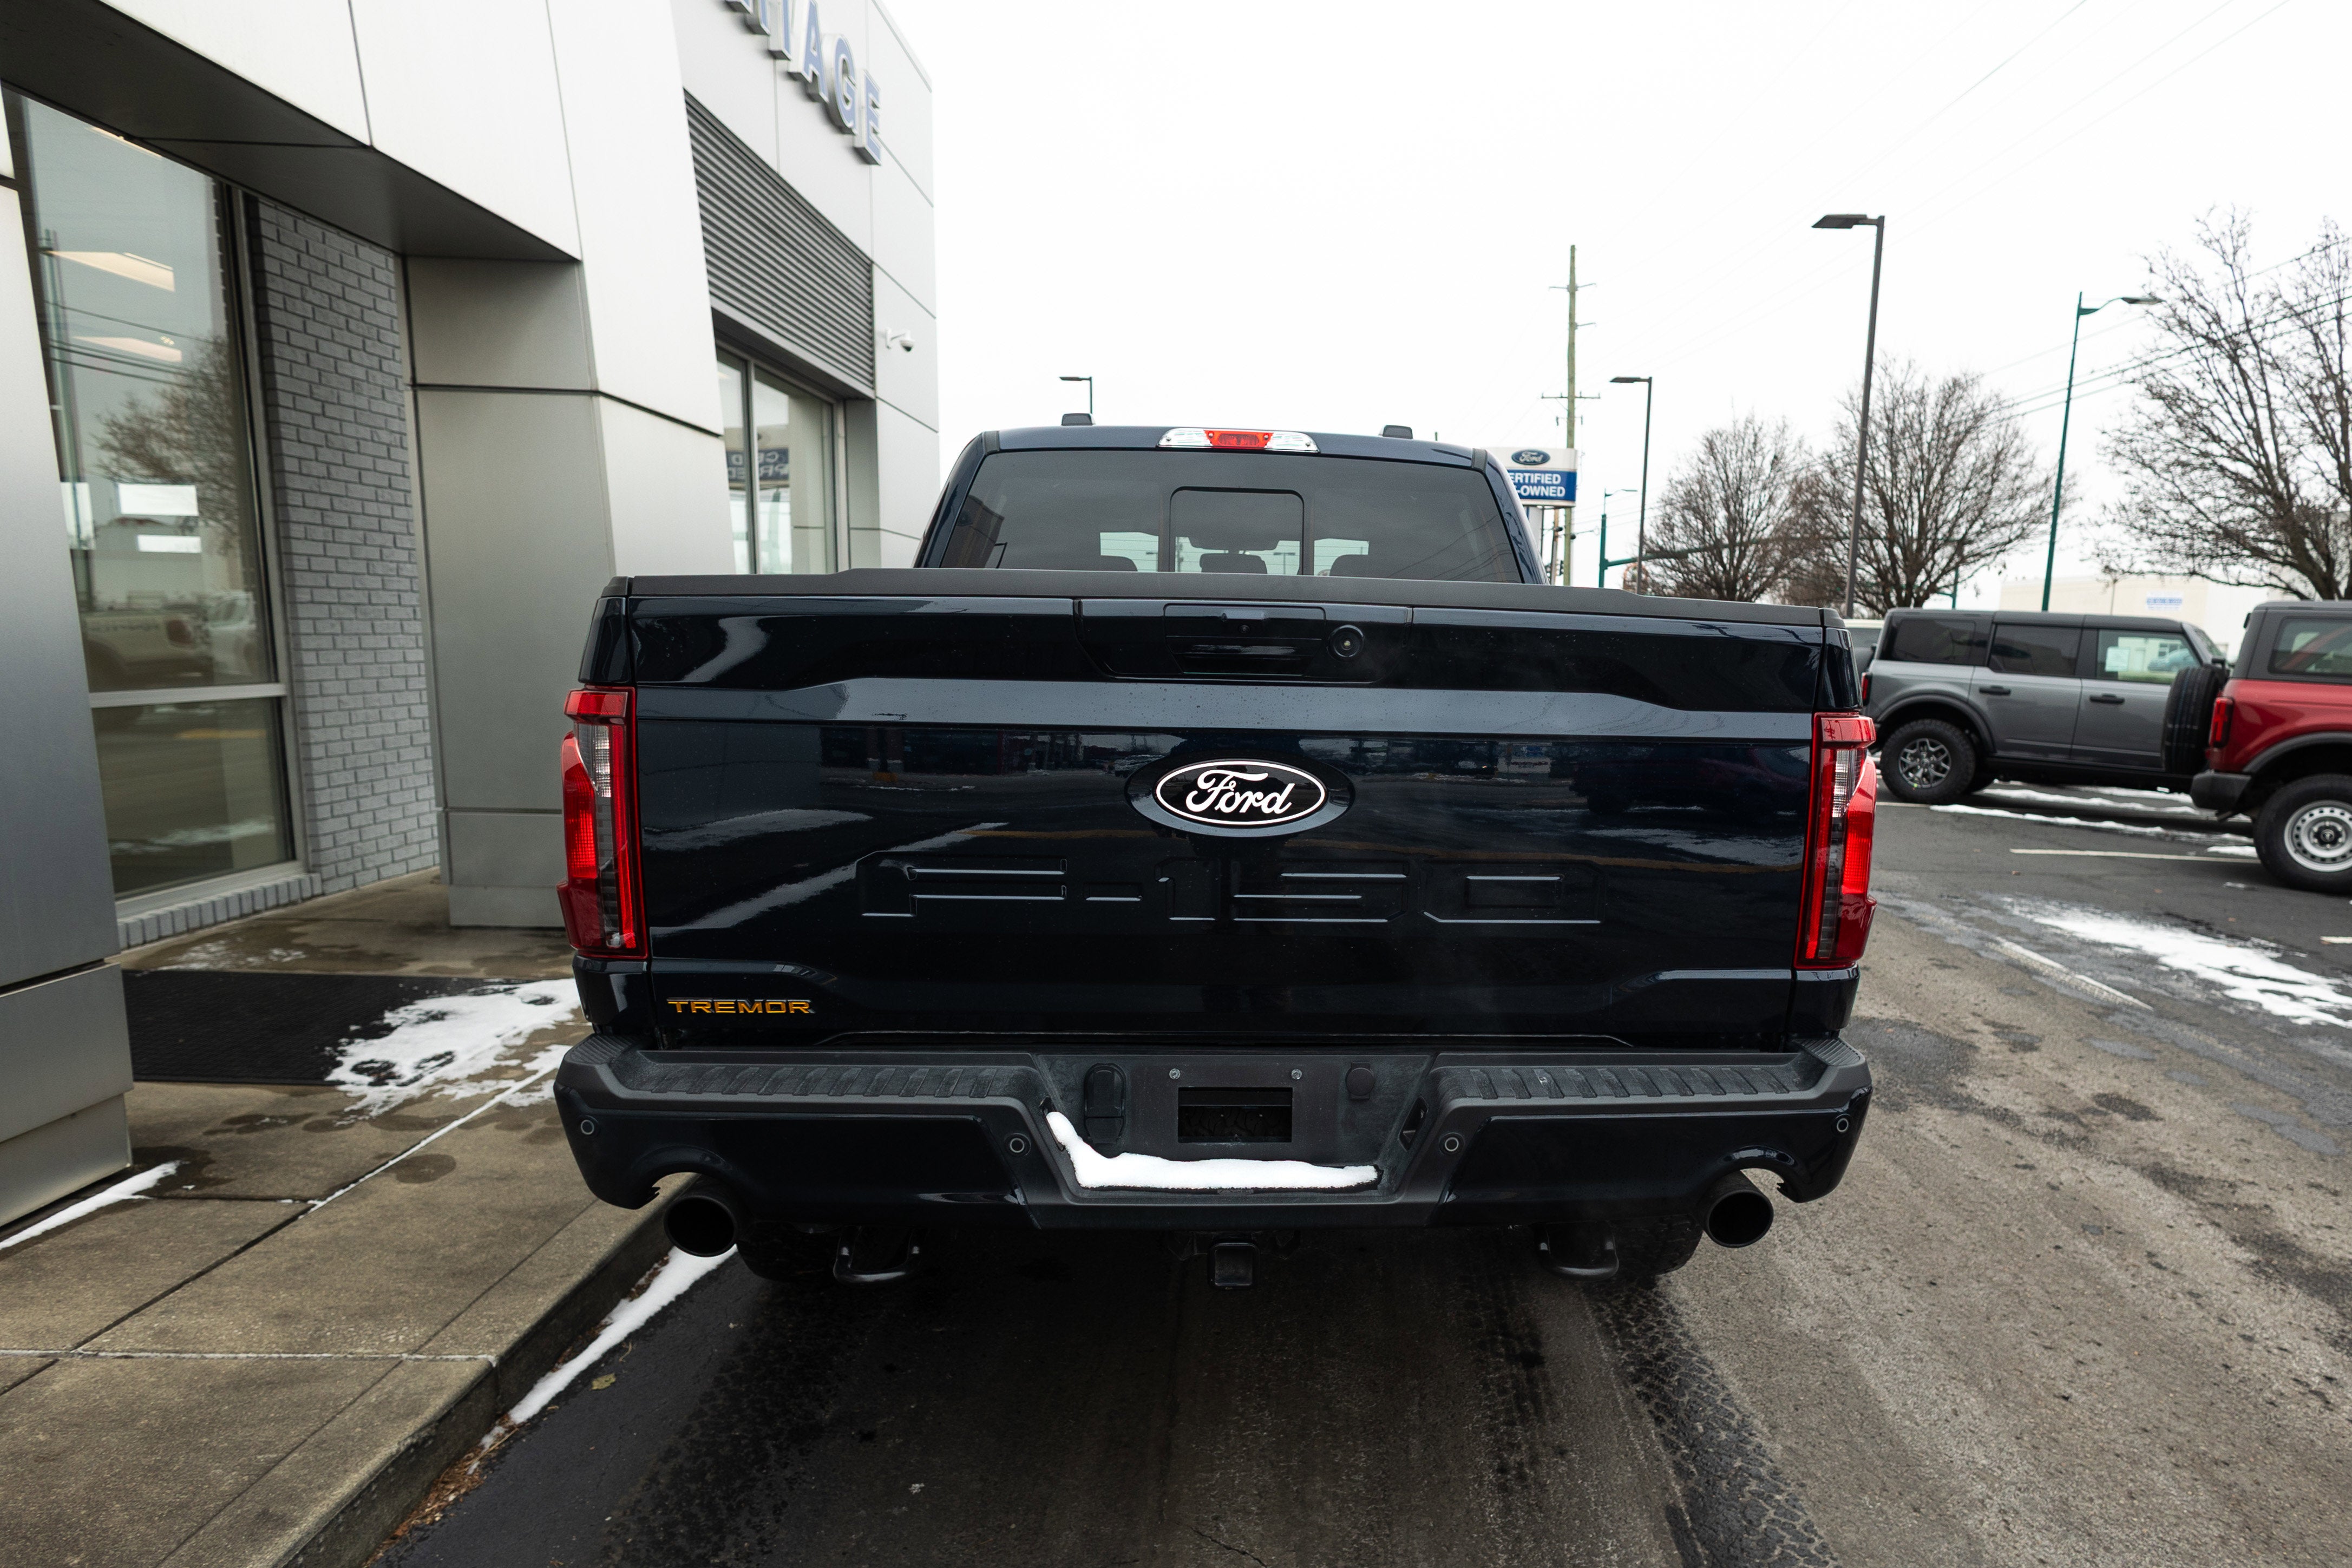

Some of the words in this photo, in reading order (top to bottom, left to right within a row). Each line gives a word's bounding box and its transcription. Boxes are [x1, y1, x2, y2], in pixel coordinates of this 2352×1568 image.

[1519, 451, 1543, 463] Ford
[1508, 473, 1561, 484] ERTIFIED
[1515, 485, 1566, 497] -OWNED
[1186, 769, 1295, 813] Ford
[857, 852, 1604, 924] F-150
[667, 999, 814, 1013] TREMOR
